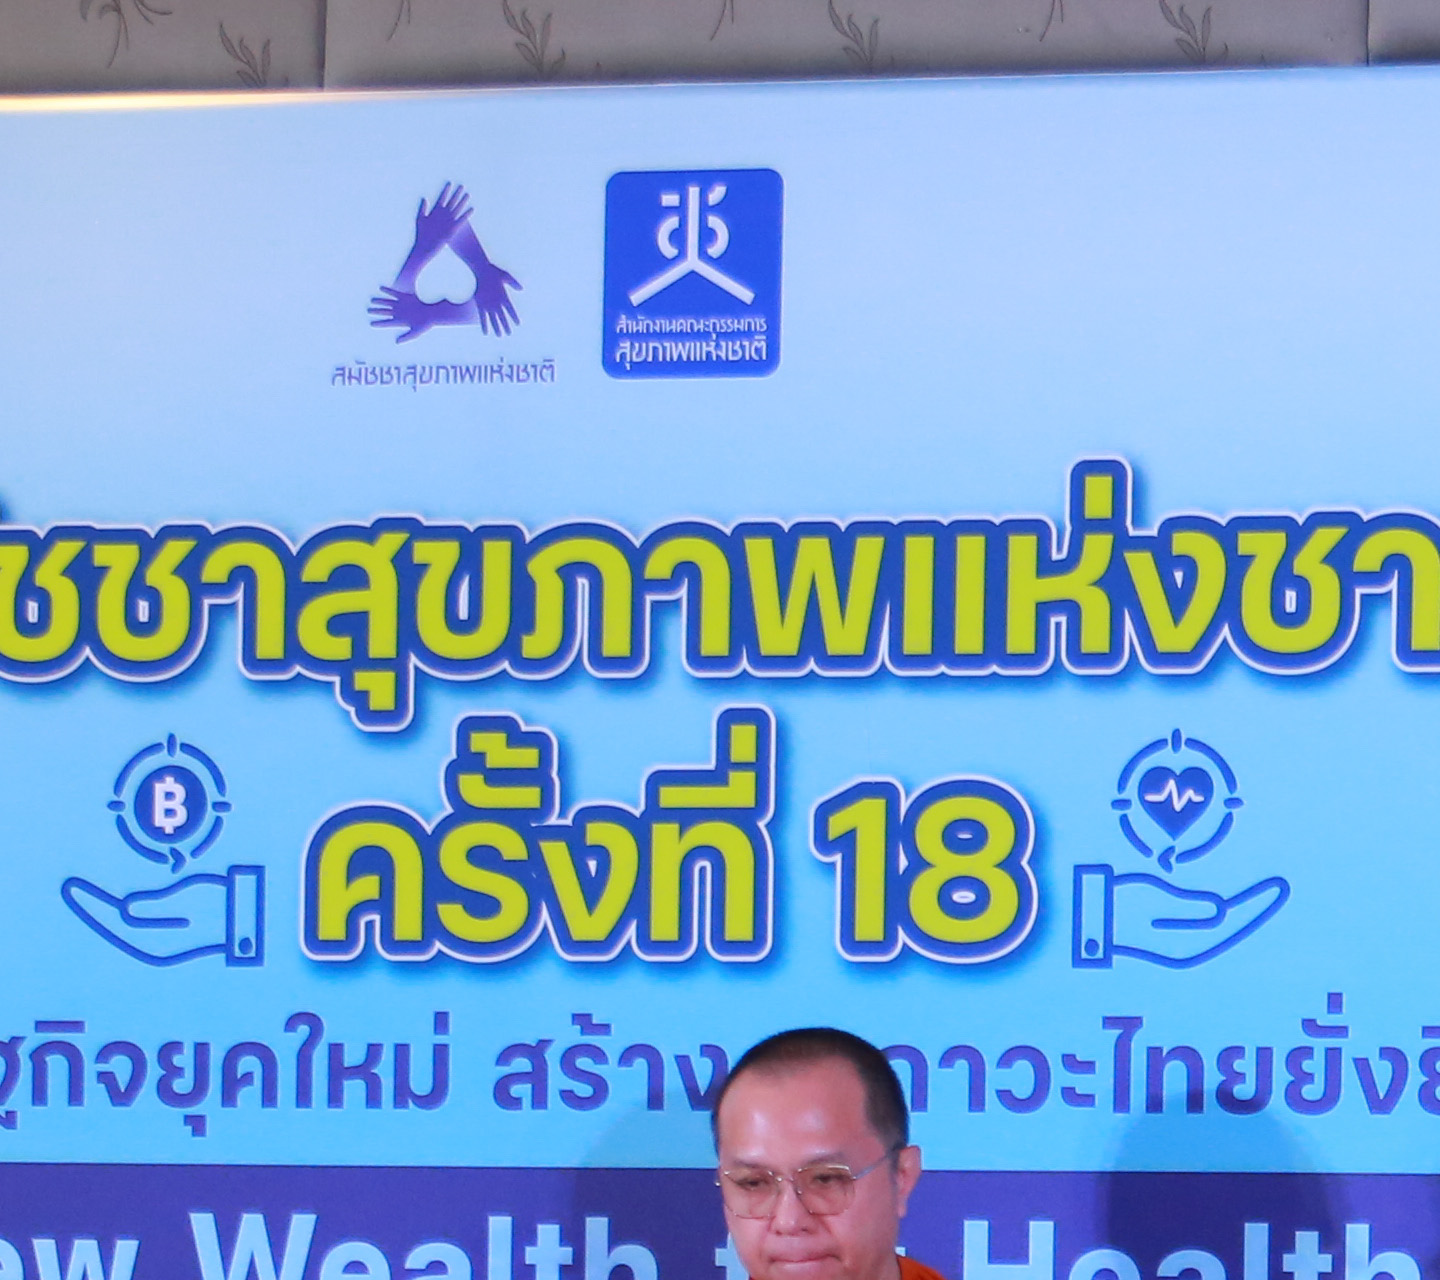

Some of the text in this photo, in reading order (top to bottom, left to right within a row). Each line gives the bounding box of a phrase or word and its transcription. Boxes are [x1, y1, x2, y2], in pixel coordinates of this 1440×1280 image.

[332, 356, 556, 392] สมัชชาสุขภาพแห่งชาติ
[312, 720, 1026, 950] ครั้งที่ 18
